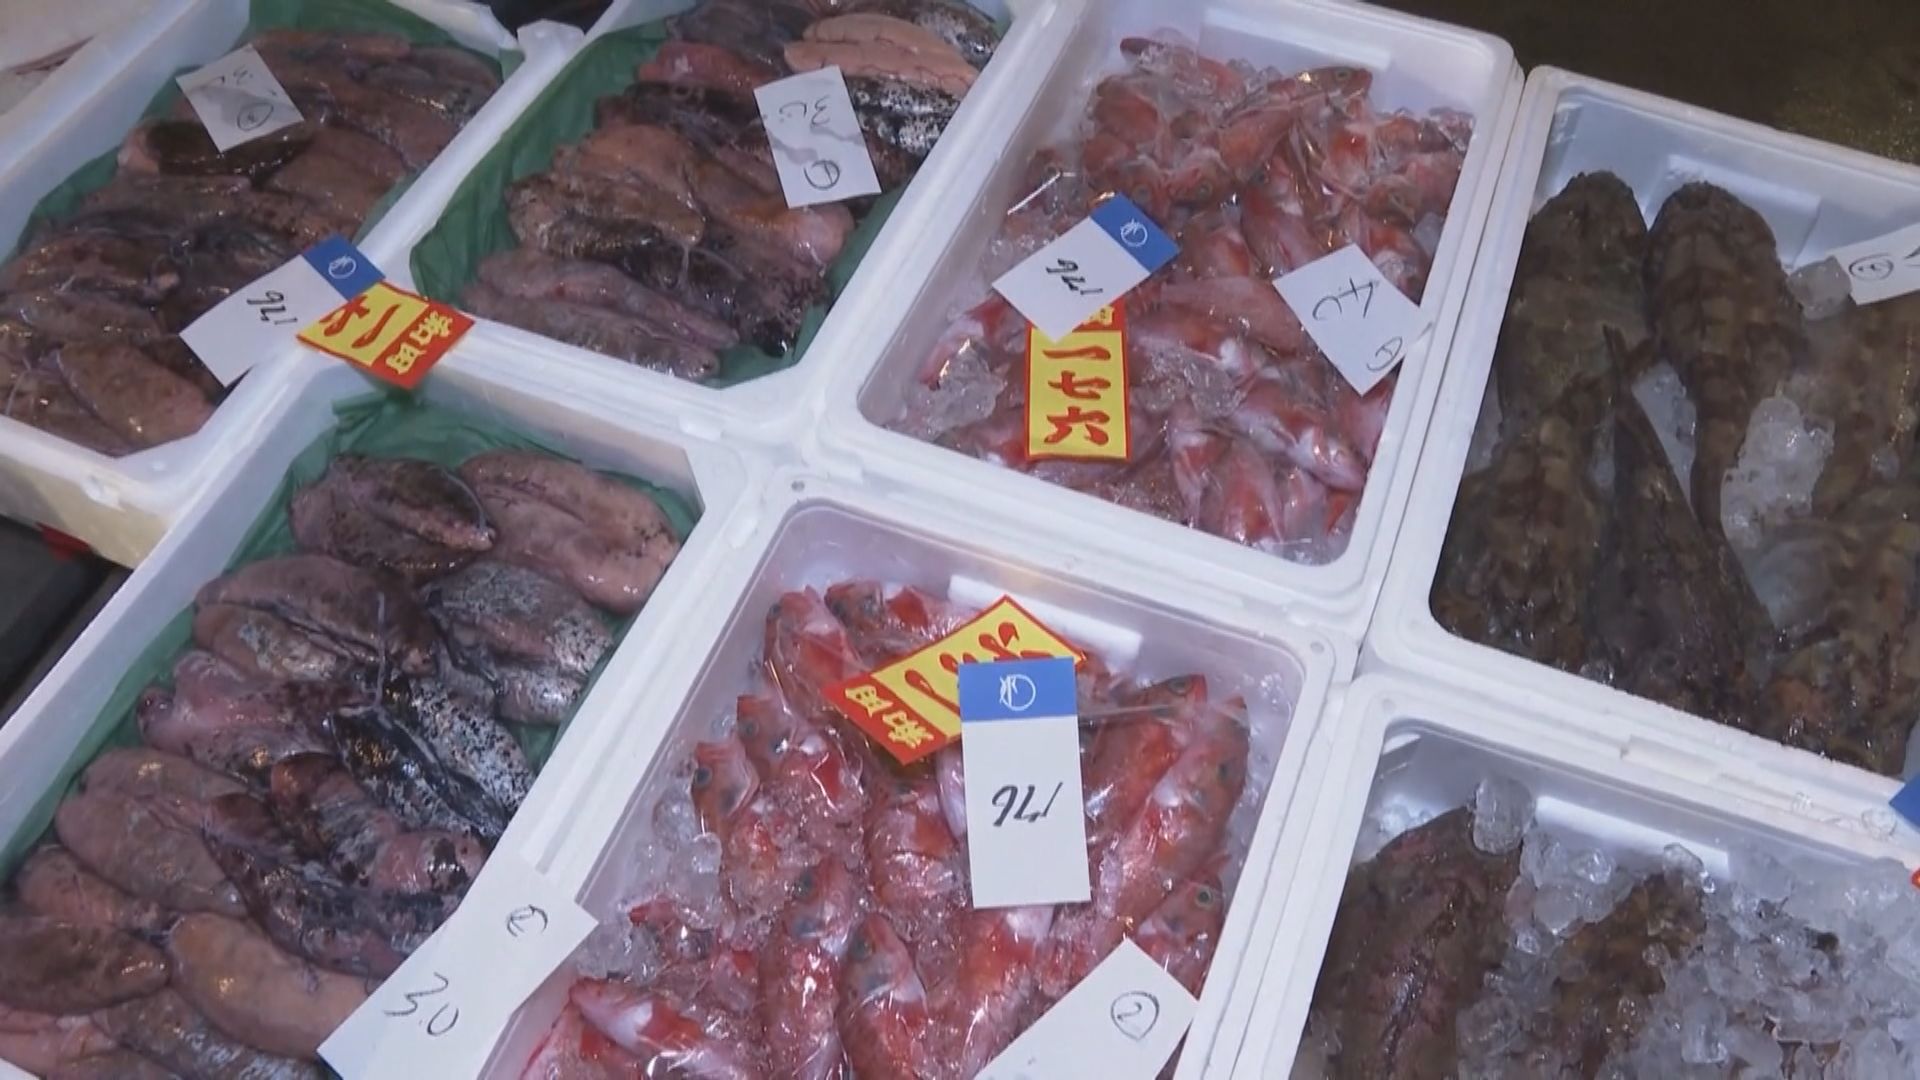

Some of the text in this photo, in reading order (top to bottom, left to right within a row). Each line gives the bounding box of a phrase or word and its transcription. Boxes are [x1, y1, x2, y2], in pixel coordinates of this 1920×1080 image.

[1042, 345, 1112, 446] 一七六
[990, 781, 1064, 828] 176
